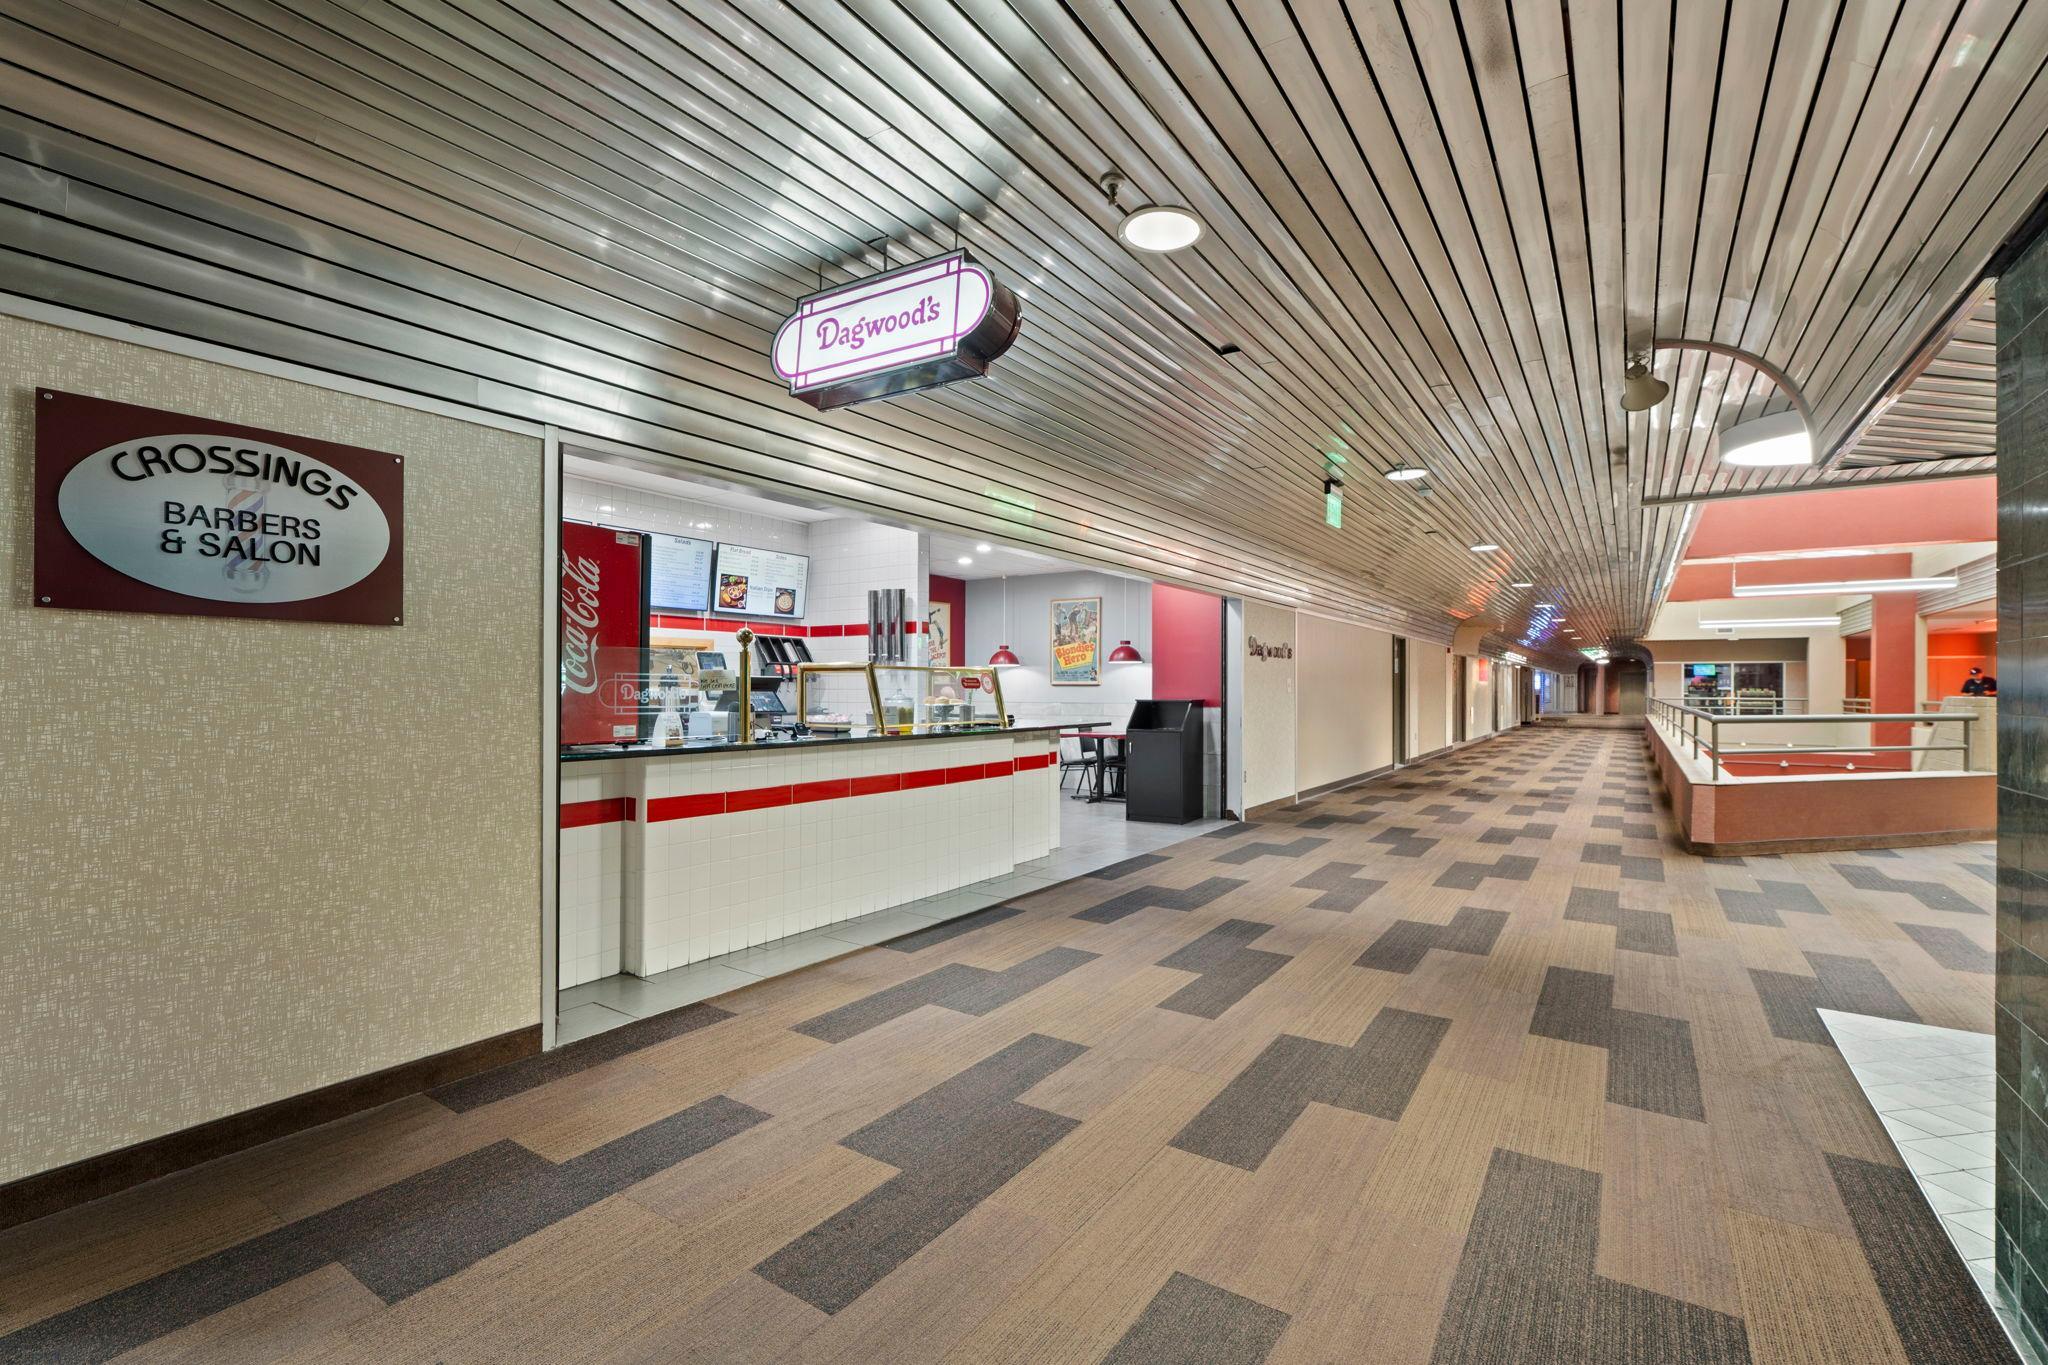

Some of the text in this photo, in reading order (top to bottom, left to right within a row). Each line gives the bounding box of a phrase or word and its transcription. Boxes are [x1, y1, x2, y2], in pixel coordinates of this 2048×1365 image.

[816, 296, 941, 350] Dagwood's
[111, 443, 359, 511] CROSSINGS
[164, 501, 321, 540] BARBERS
[160, 528, 321, 567] & SALON
[674, 537, 692, 546] Salads
[1063, 654, 1087, 666] Hero
